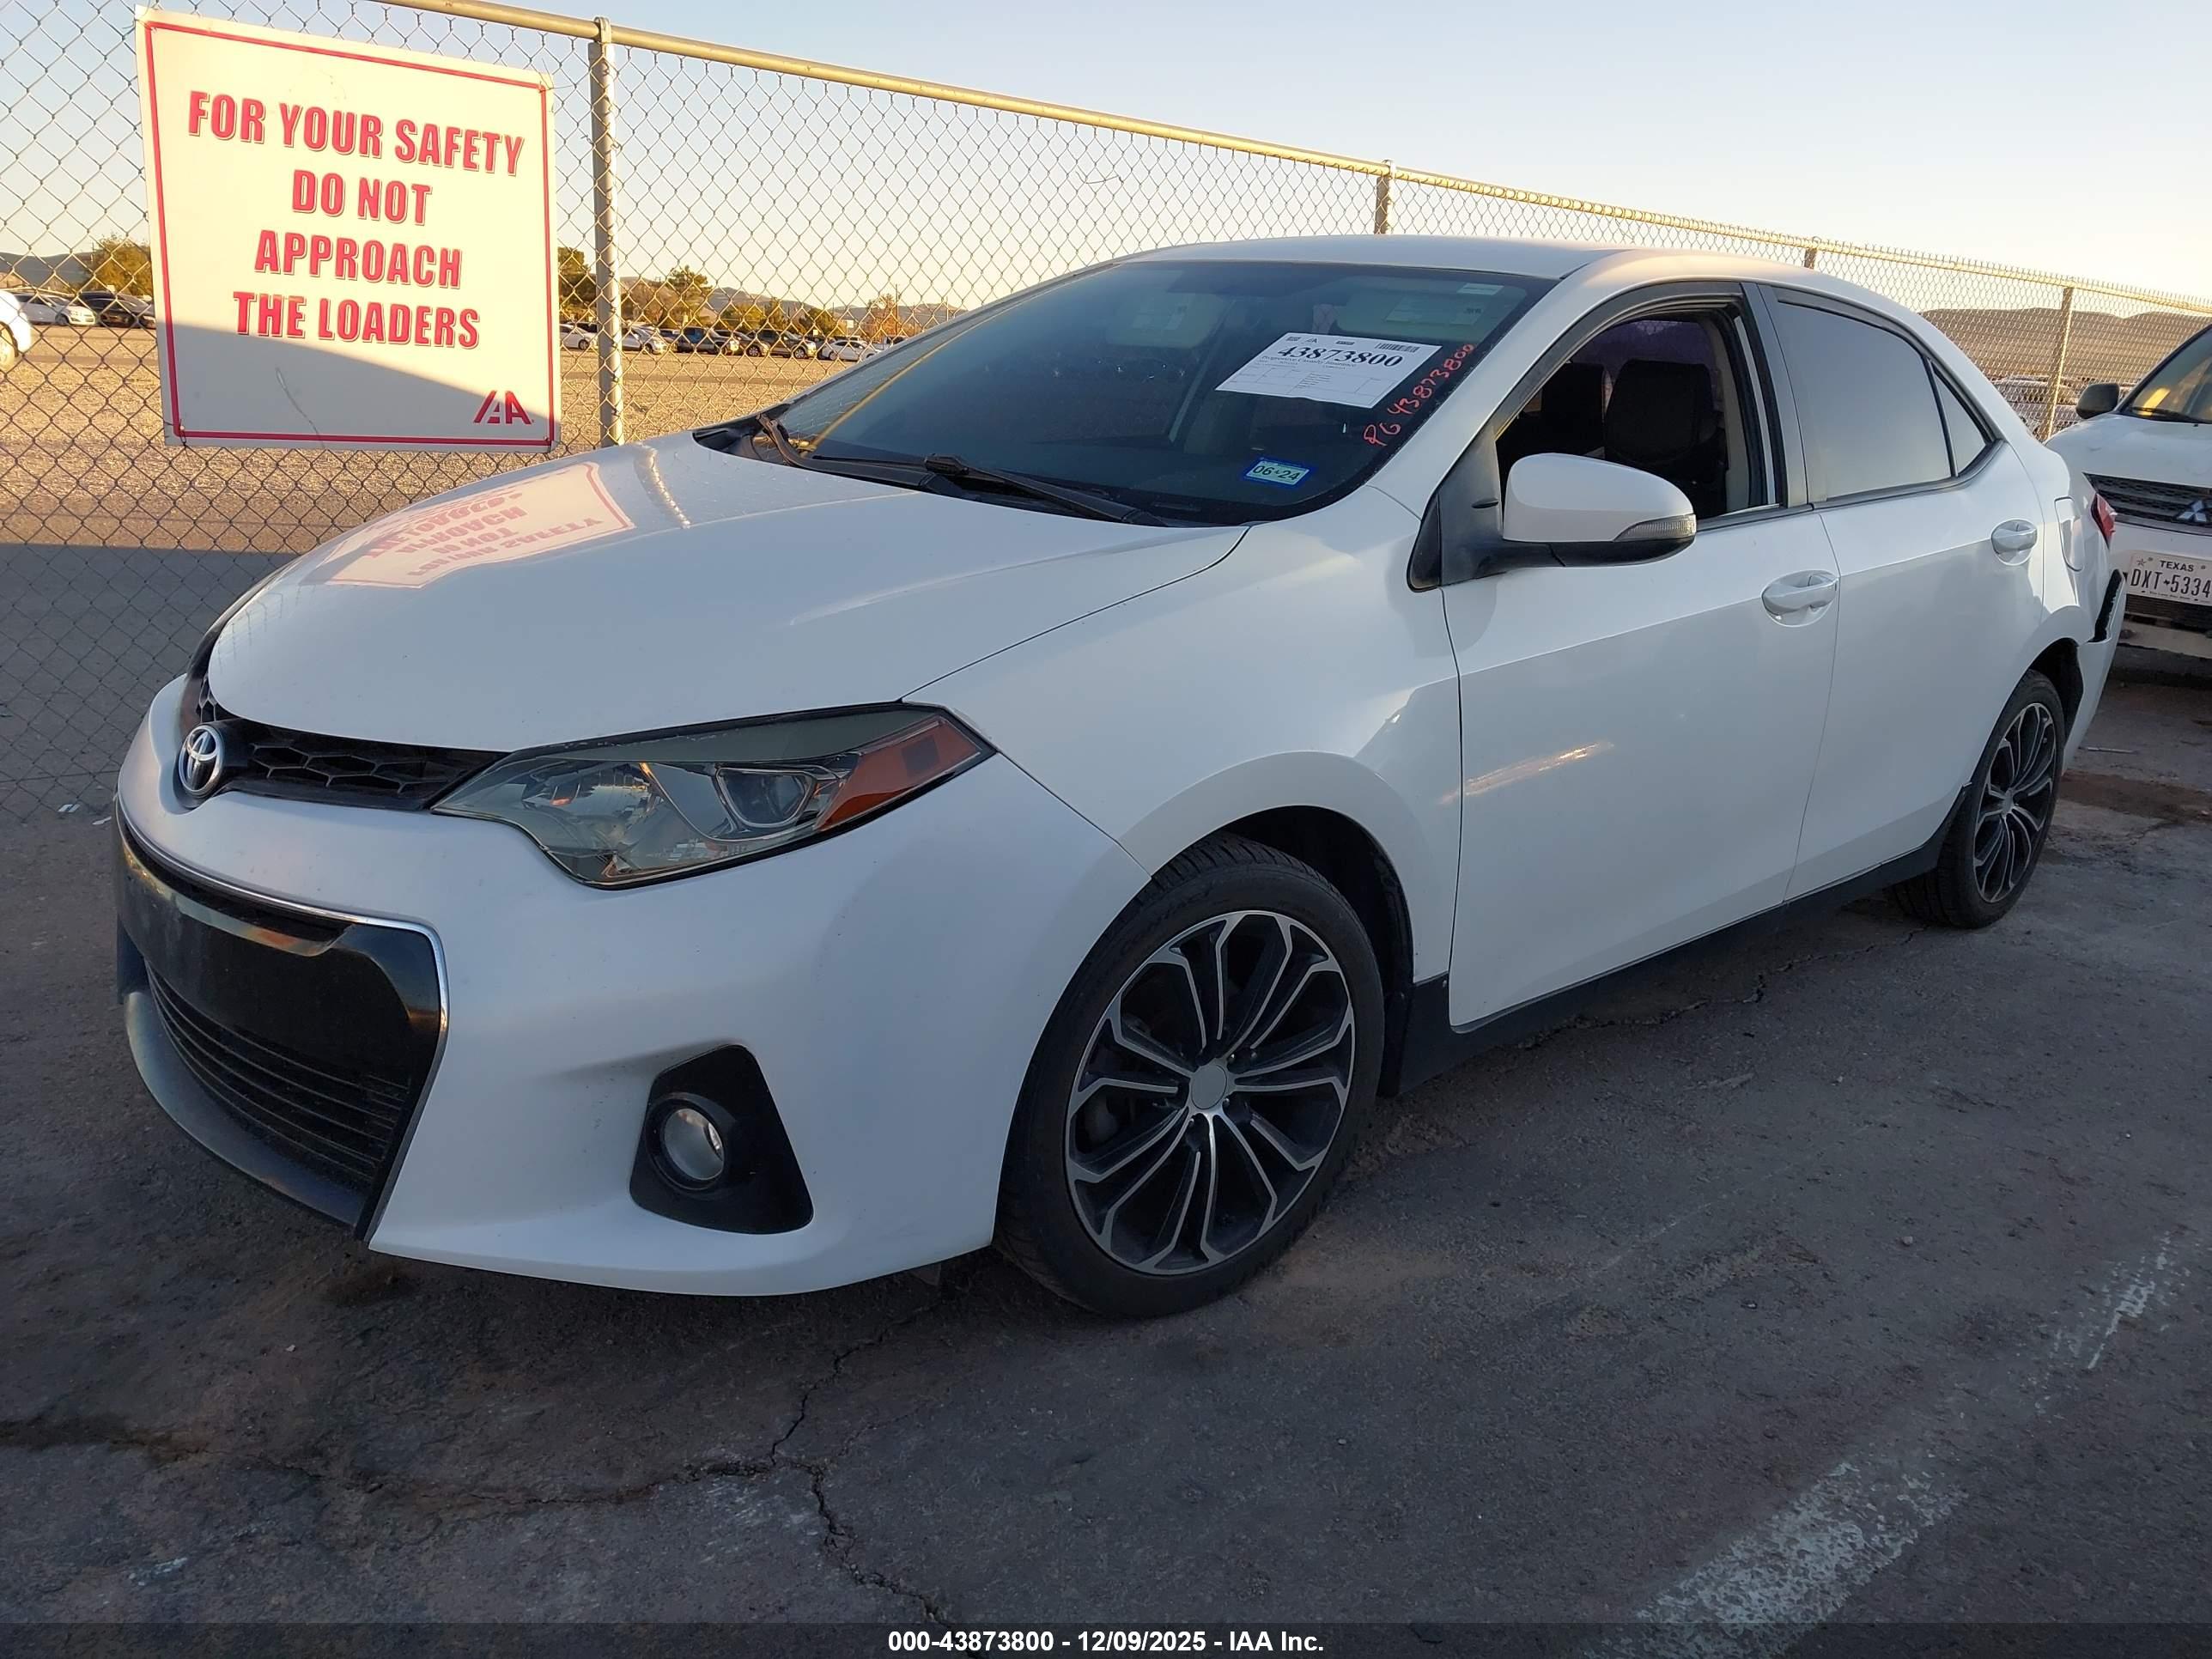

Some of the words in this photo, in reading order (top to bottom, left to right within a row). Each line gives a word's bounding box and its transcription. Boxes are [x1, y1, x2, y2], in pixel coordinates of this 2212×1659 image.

[189, 90, 264, 143] FOR
[279, 102, 382, 158] YOUR
[394, 118, 525, 175] SAFETY
[292, 169, 343, 216] DO
[358, 177, 432, 225] NOT
[254, 229, 462, 289] APPROACH
[233, 291, 306, 338] THE
[318, 298, 480, 349] LOADERS
[1277, 345, 1403, 368] 43873800
[1387, 343, 1474, 415] 43873800
[2160, 560, 2194, 572] TEXAS
